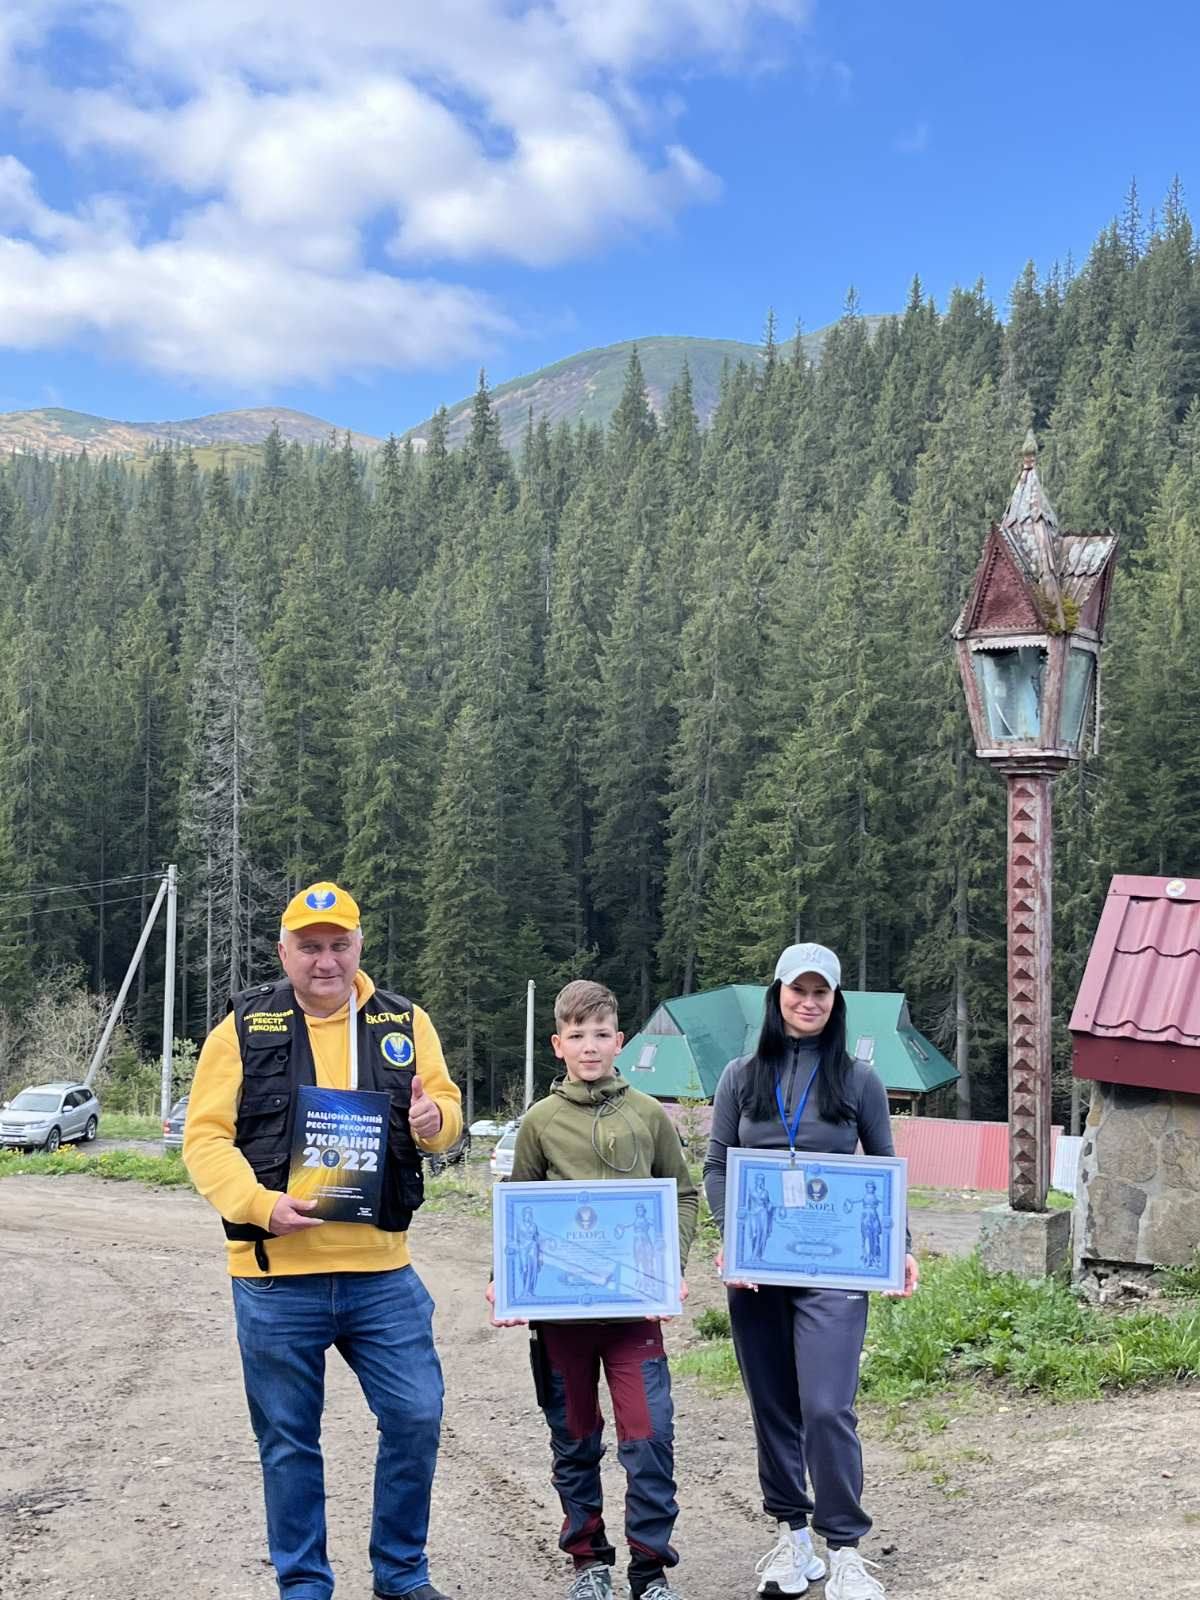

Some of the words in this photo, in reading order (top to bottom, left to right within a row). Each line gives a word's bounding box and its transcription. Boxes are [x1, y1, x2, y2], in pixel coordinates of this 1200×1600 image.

[365, 1011, 410, 1024] ЕКСПЕРТ
[307, 1110, 383, 1124] НАЦІОНАЛЬНИЙ
[305, 1120, 337, 1130] РЕЄСТР
[339, 1124, 381, 1133] РЕКОРДІВ
[305, 1132, 380, 1150] УКРАЇНИ
[302, 1146, 378, 1172] 2022
[566, 1231, 607, 1240] РЕКОРД
